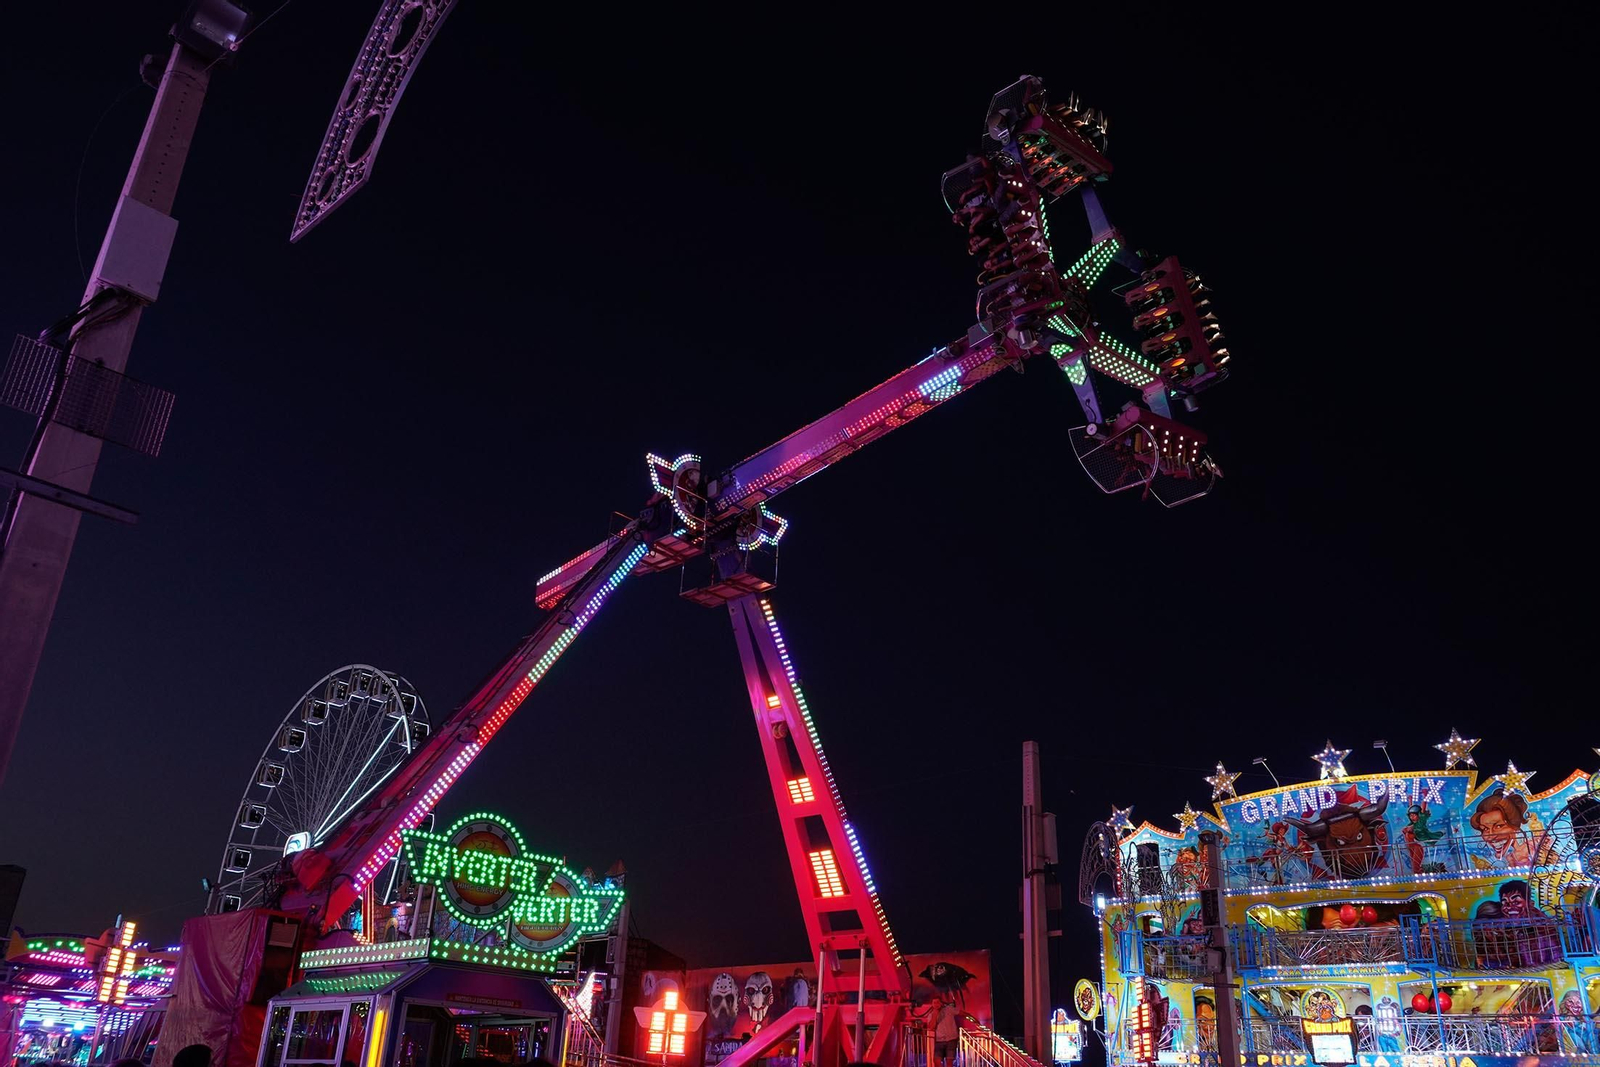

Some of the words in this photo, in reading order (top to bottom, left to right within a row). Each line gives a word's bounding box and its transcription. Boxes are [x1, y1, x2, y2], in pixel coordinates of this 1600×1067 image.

[1240, 784, 1338, 824] GRAND
[1368, 778, 1447, 806] PRIX
[511, 894, 600, 924] VERTER
[1303, 967, 1329, 975] TODA
[1348, 965, 1388, 974] FAMILIA
[1174, 1054, 1247, 1065] GRAD
[1257, 1054, 1307, 1065] PRIX
[1359, 1055, 1390, 1067] LA
